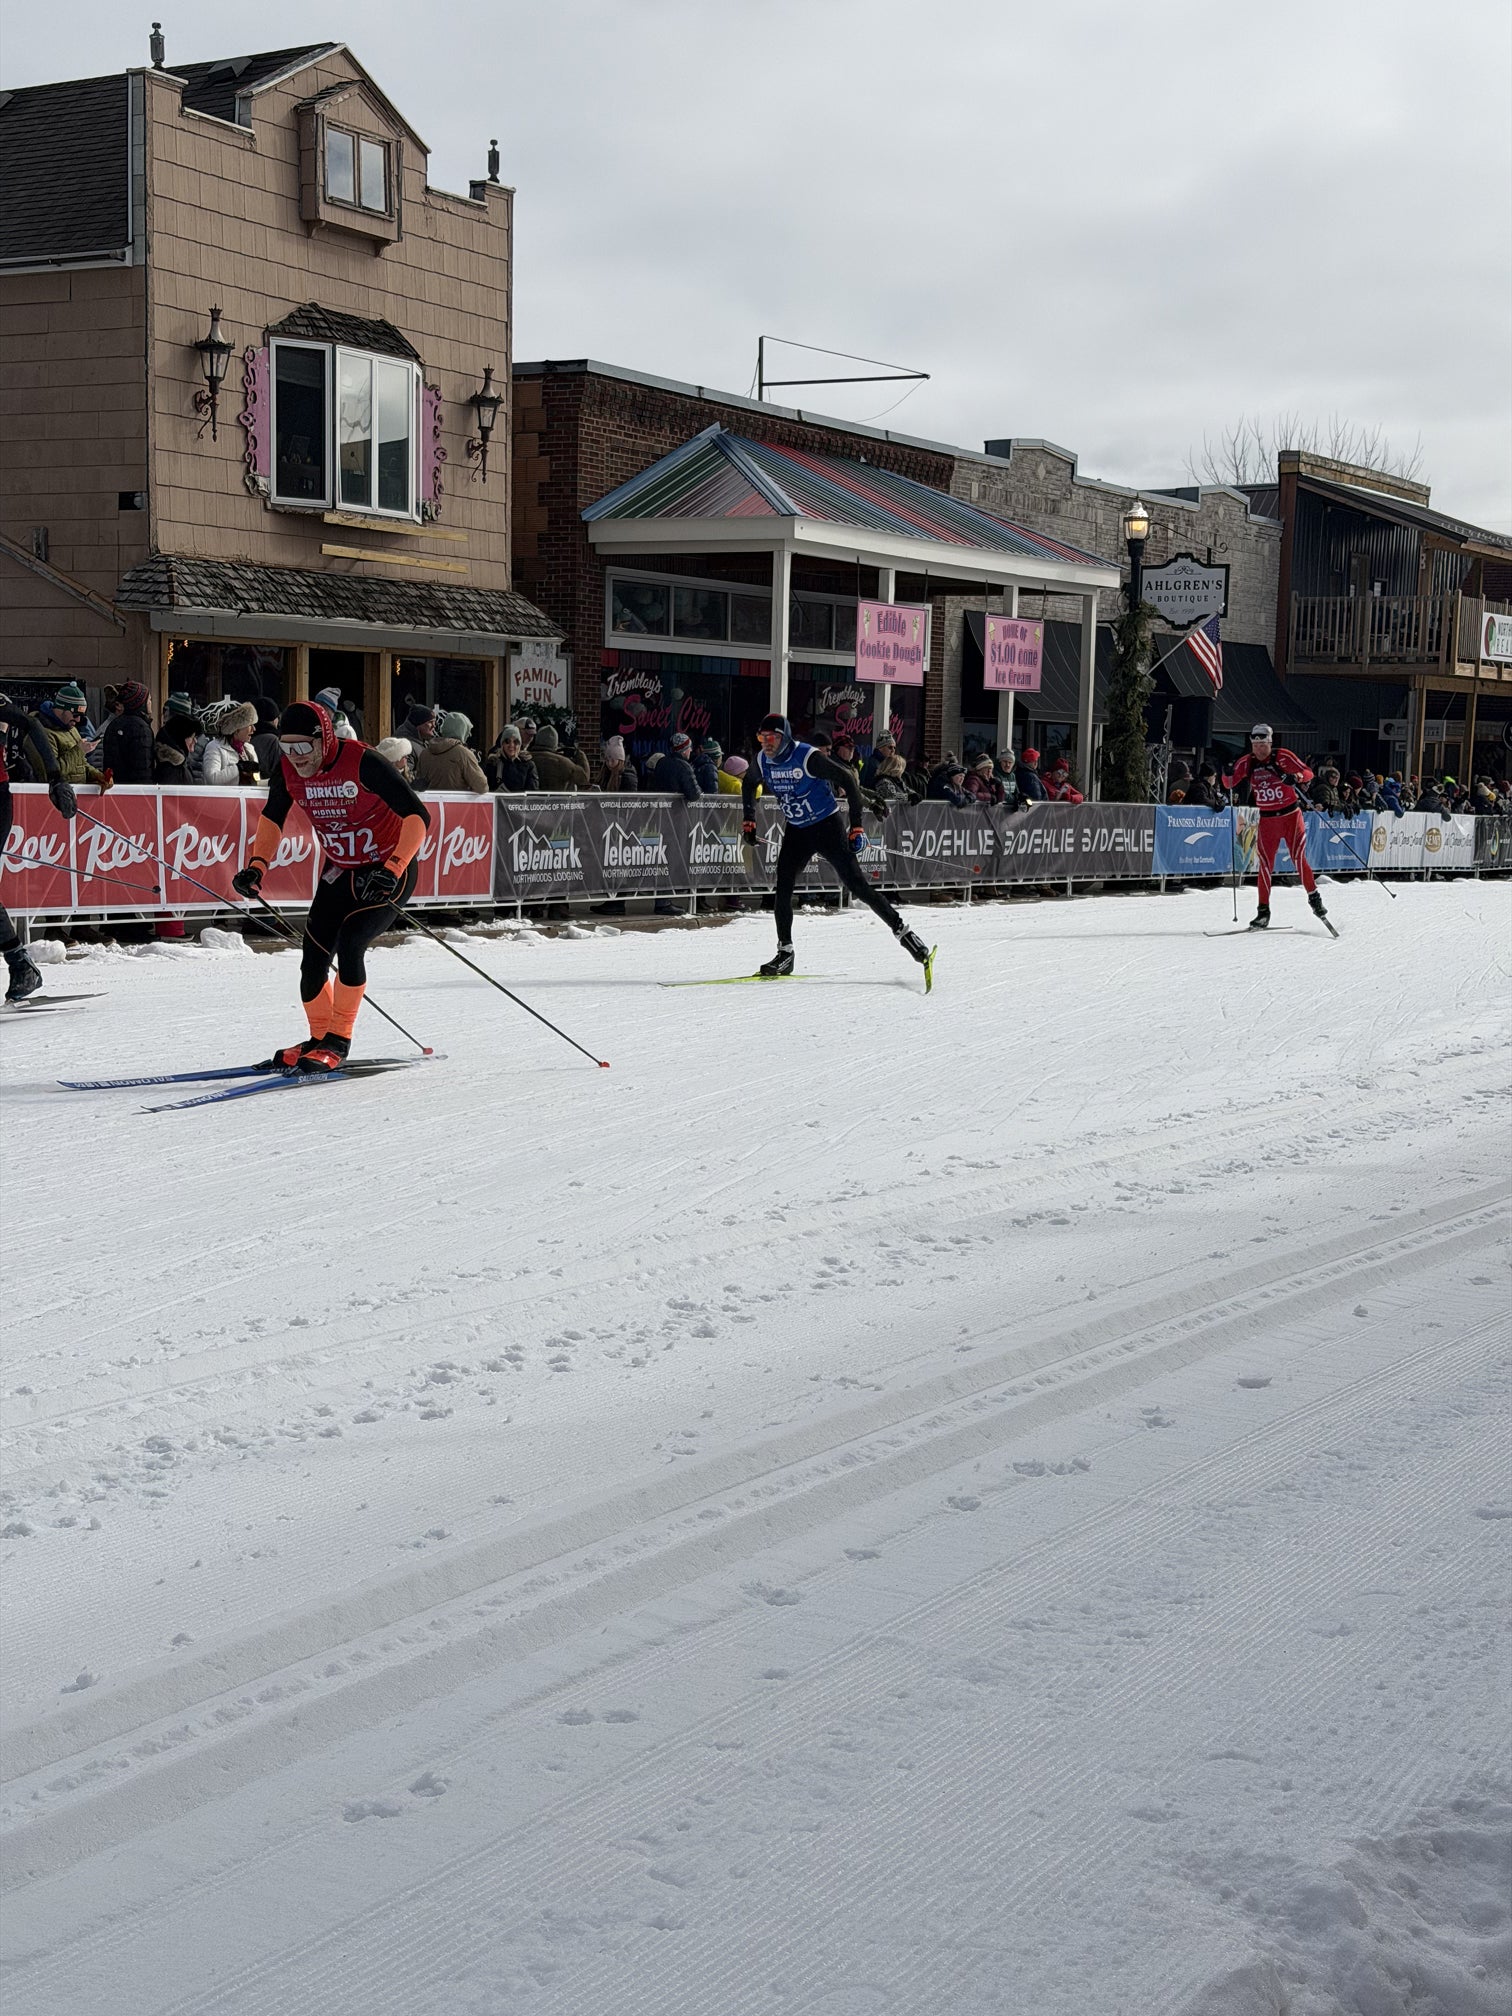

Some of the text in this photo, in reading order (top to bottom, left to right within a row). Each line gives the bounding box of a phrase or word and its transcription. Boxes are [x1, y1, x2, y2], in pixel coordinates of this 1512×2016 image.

[1144, 580, 1223, 591] AHLGREN'S
[1157, 595, 1209, 603] BOUTIQUE
[876, 611, 906, 637] Edible
[860, 639, 922, 666] Cookie Dough
[990, 640, 1038, 668] $1.00 cone
[514, 667, 562, 688] FAMILY
[883, 662, 897, 677] Bar
[995, 666, 1032, 686] Ice Cream
[524, 687, 552, 703] FUN
[607, 671, 663, 698] Tremblay's
[822, 685, 866, 709] Tremblay's
[619, 694, 711, 736] Sweet City
[832, 702, 904, 743] Sweet ity
[305, 785, 344, 800] BIRKIE
[1253, 786, 1284, 802] 2396
[1167, 815, 1196, 828] FRANDSEN
[78, 822, 154, 882] Rex
[165, 822, 237, 881] Rex
[443, 826, 490, 876] Rex
[508, 825, 583, 873] Telemark
[602, 822, 669, 867] Telemark
[513, 871, 584, 885] NORTHWOODS LODGING
[602, 867, 669, 878] NORTHWOODS LODGING
[721, 865, 746, 874] LODGING
